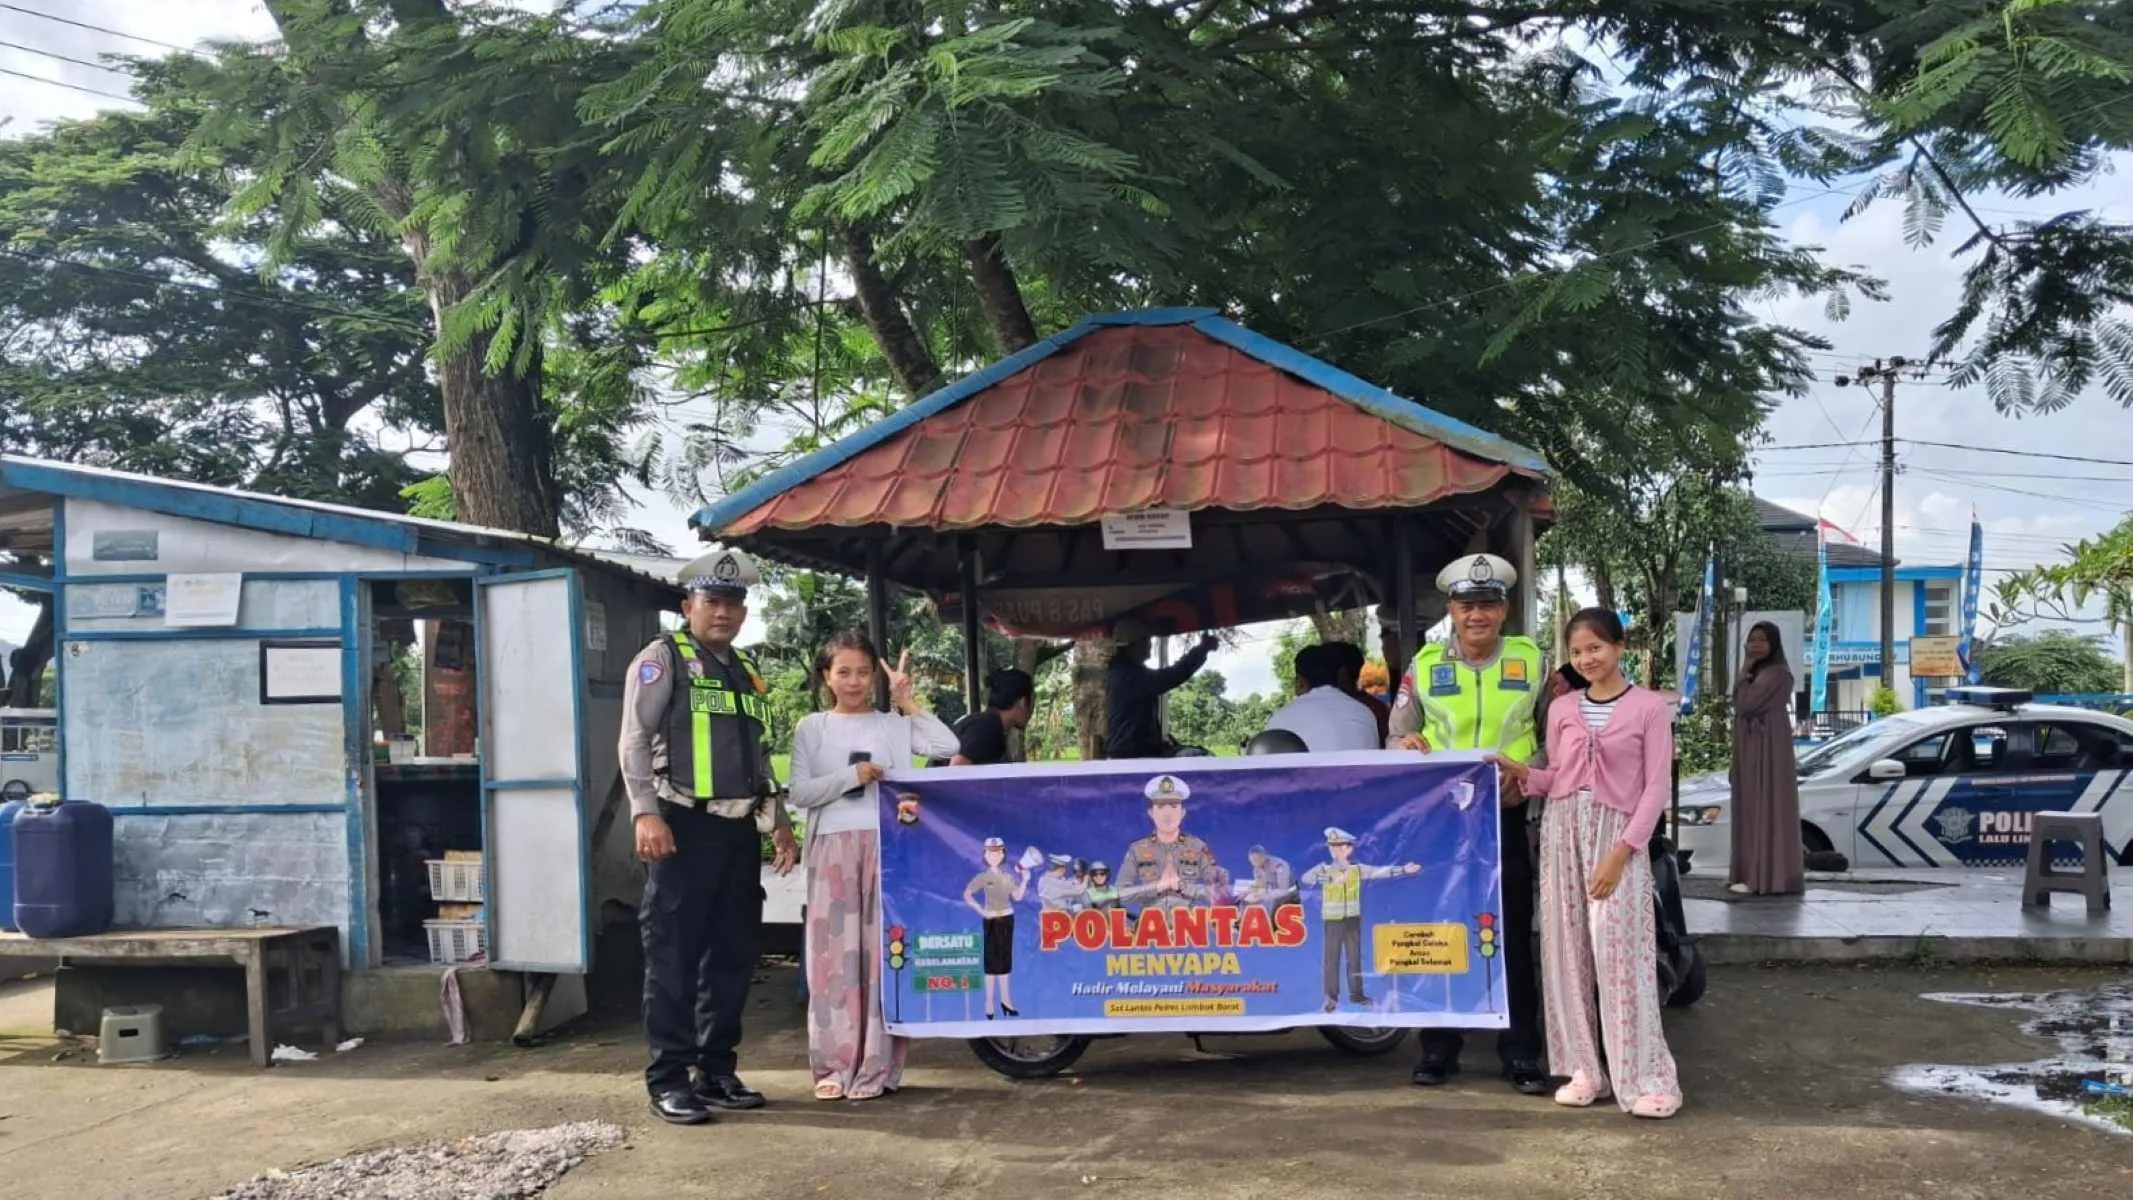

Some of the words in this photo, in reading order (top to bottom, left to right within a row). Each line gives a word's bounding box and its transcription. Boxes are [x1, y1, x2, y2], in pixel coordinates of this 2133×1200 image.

[1979, 811, 2032, 833] POLI
[1979, 835, 2010, 844] LALU
[1041, 904, 1307, 950] POLANTAS
[918, 935, 974, 950] BERSATU
[1106, 952, 1242, 977] MENYAPA
[1072, 981, 1114, 996] Hadir
[1116, 980, 1184, 998] Melayani
[1186, 980, 1278, 997] Masyarakat
